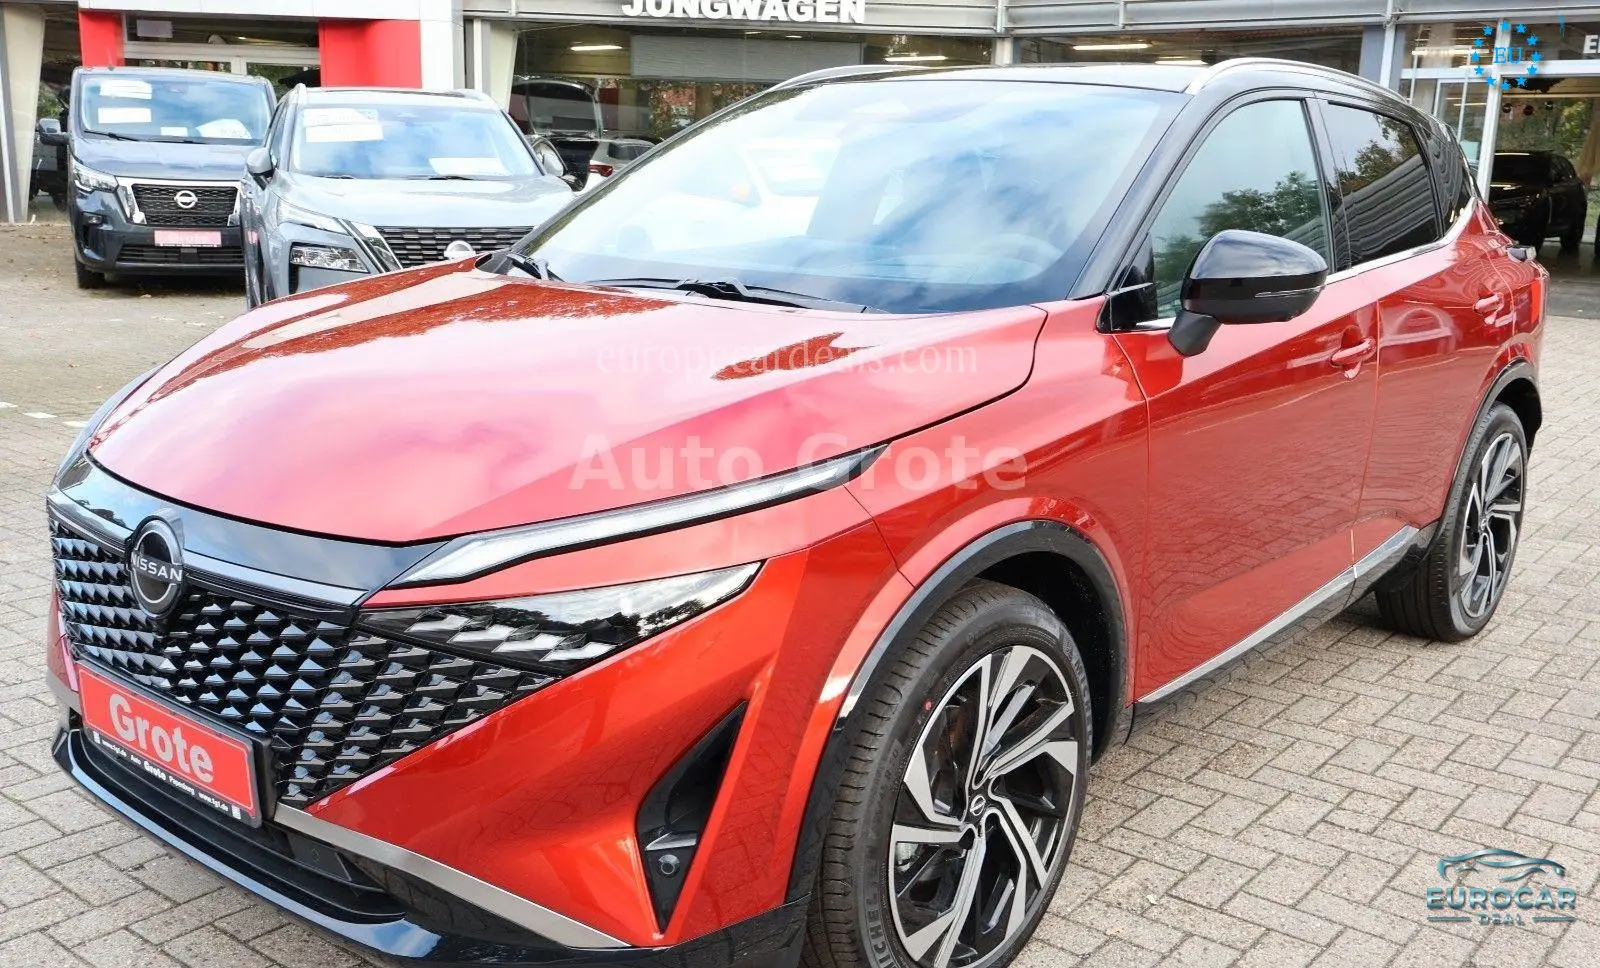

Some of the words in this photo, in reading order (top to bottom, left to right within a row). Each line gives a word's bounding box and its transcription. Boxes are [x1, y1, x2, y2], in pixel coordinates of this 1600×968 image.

[621, 0, 865, 23] JUNGWAGEN
[131, 550, 182, 582] NISSAN
[109, 693, 214, 783] Grote
[143, 761, 166, 781] Grote
